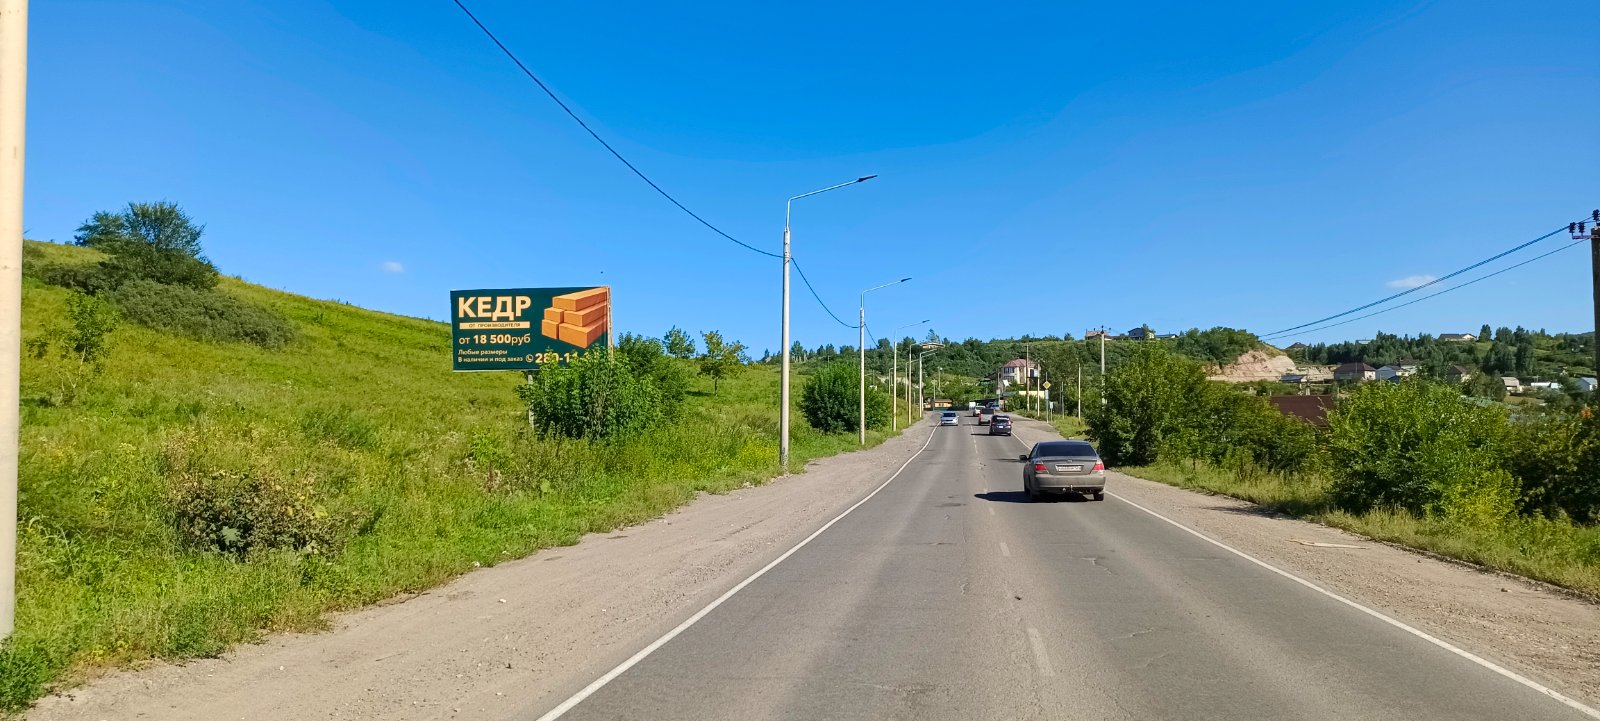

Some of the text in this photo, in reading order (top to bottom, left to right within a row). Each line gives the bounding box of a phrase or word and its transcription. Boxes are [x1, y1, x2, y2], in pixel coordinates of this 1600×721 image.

[458, 295, 532, 321] КЕДР
[473, 334, 487, 344] 18
[490, 333, 531, 346] 500руб
